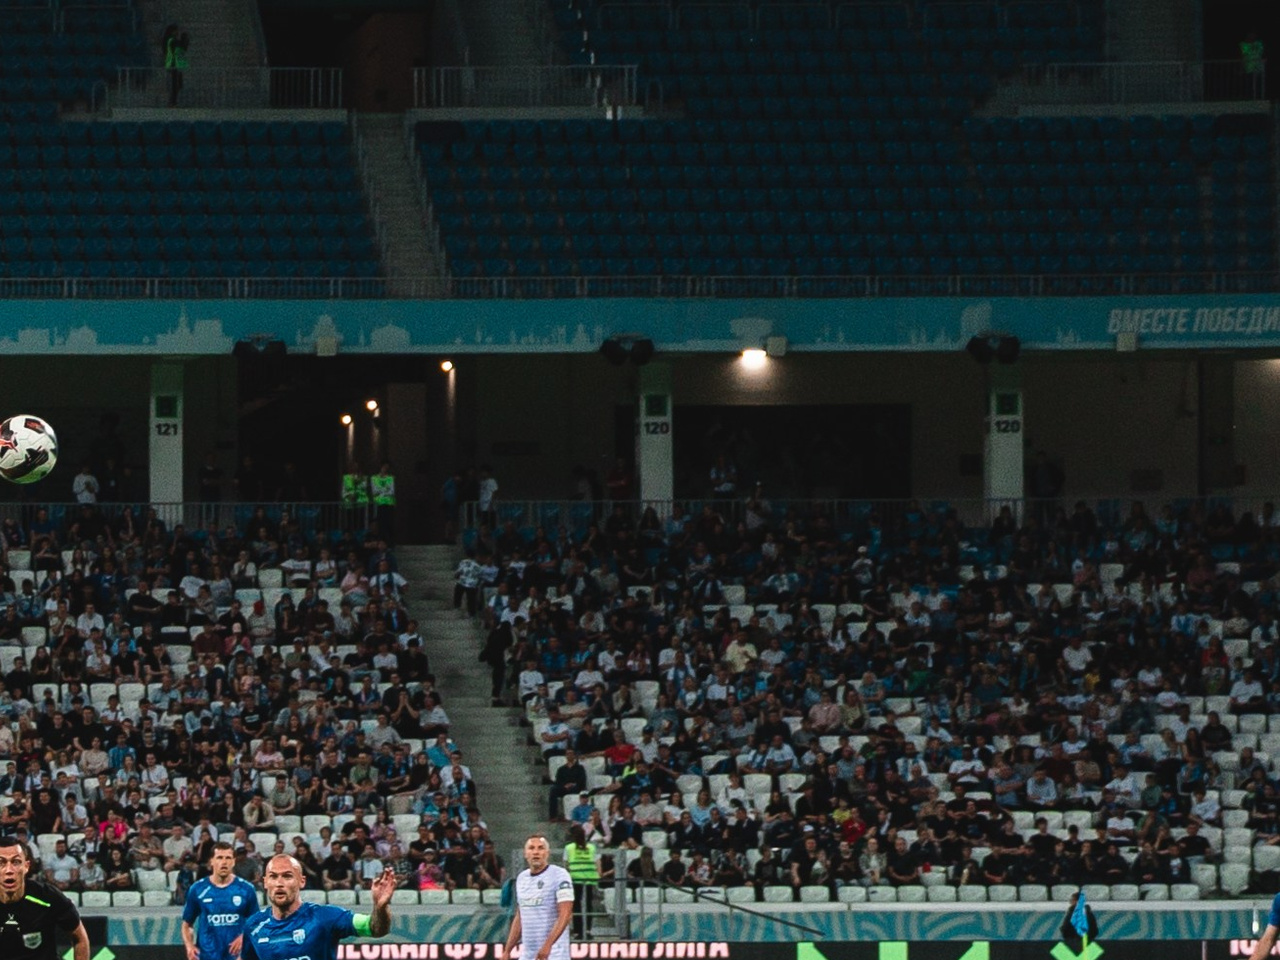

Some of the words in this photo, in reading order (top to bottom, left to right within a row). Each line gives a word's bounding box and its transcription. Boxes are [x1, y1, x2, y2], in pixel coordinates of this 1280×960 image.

[1107, 308, 1190, 334] ВМЕСТЕ
[155, 423, 178, 437] 121
[644, 422, 670, 435] 120
